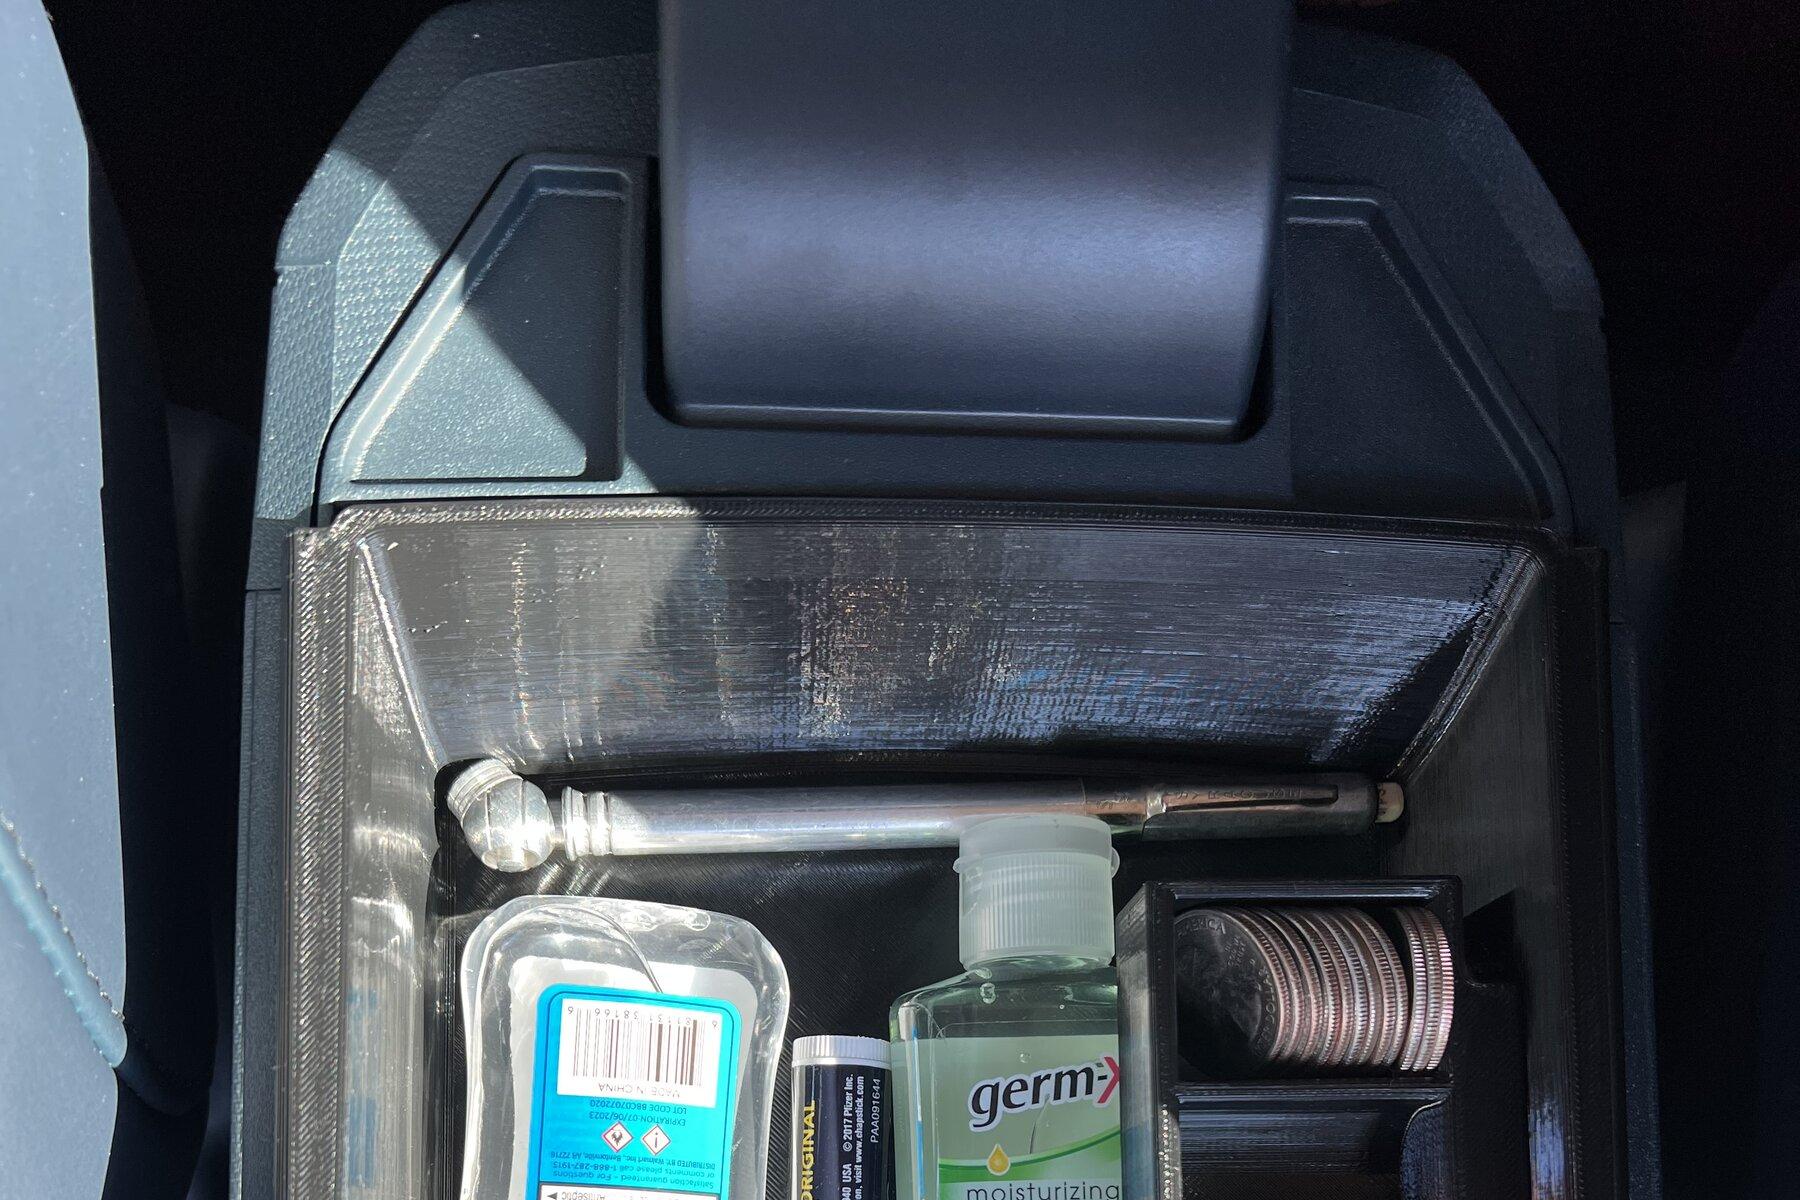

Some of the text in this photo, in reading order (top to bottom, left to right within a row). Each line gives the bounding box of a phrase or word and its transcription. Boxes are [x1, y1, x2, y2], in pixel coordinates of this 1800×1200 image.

[844, 1074, 853, 1090] Inc.
[598, 1083, 632, 1094] CHINA
[650, 1104, 671, 1112] CODE
[844, 1092, 853, 1116] Pfizer
[673, 1106, 687, 1114] LOT
[870, 1078, 881, 1143] PAA091644
[855, 1076, 865, 1162] www.chapstick.com
[843, 1119, 853, 1140] 2017
[637, 1165, 662, 1174] please
[677, 1160, 715, 1169] DISTRIBUTED
[553, 1171, 594, 1179] questions
[597, 1173, 611, 1181] For
[665, 1168, 704, 1177] comments
[842, 1164, 852, 1183] USA
[854, 1164, 863, 1183] visit
[621, 1174, 667, 1184] guaranteed
[671, 1179, 713, 1188] Satisfaction
